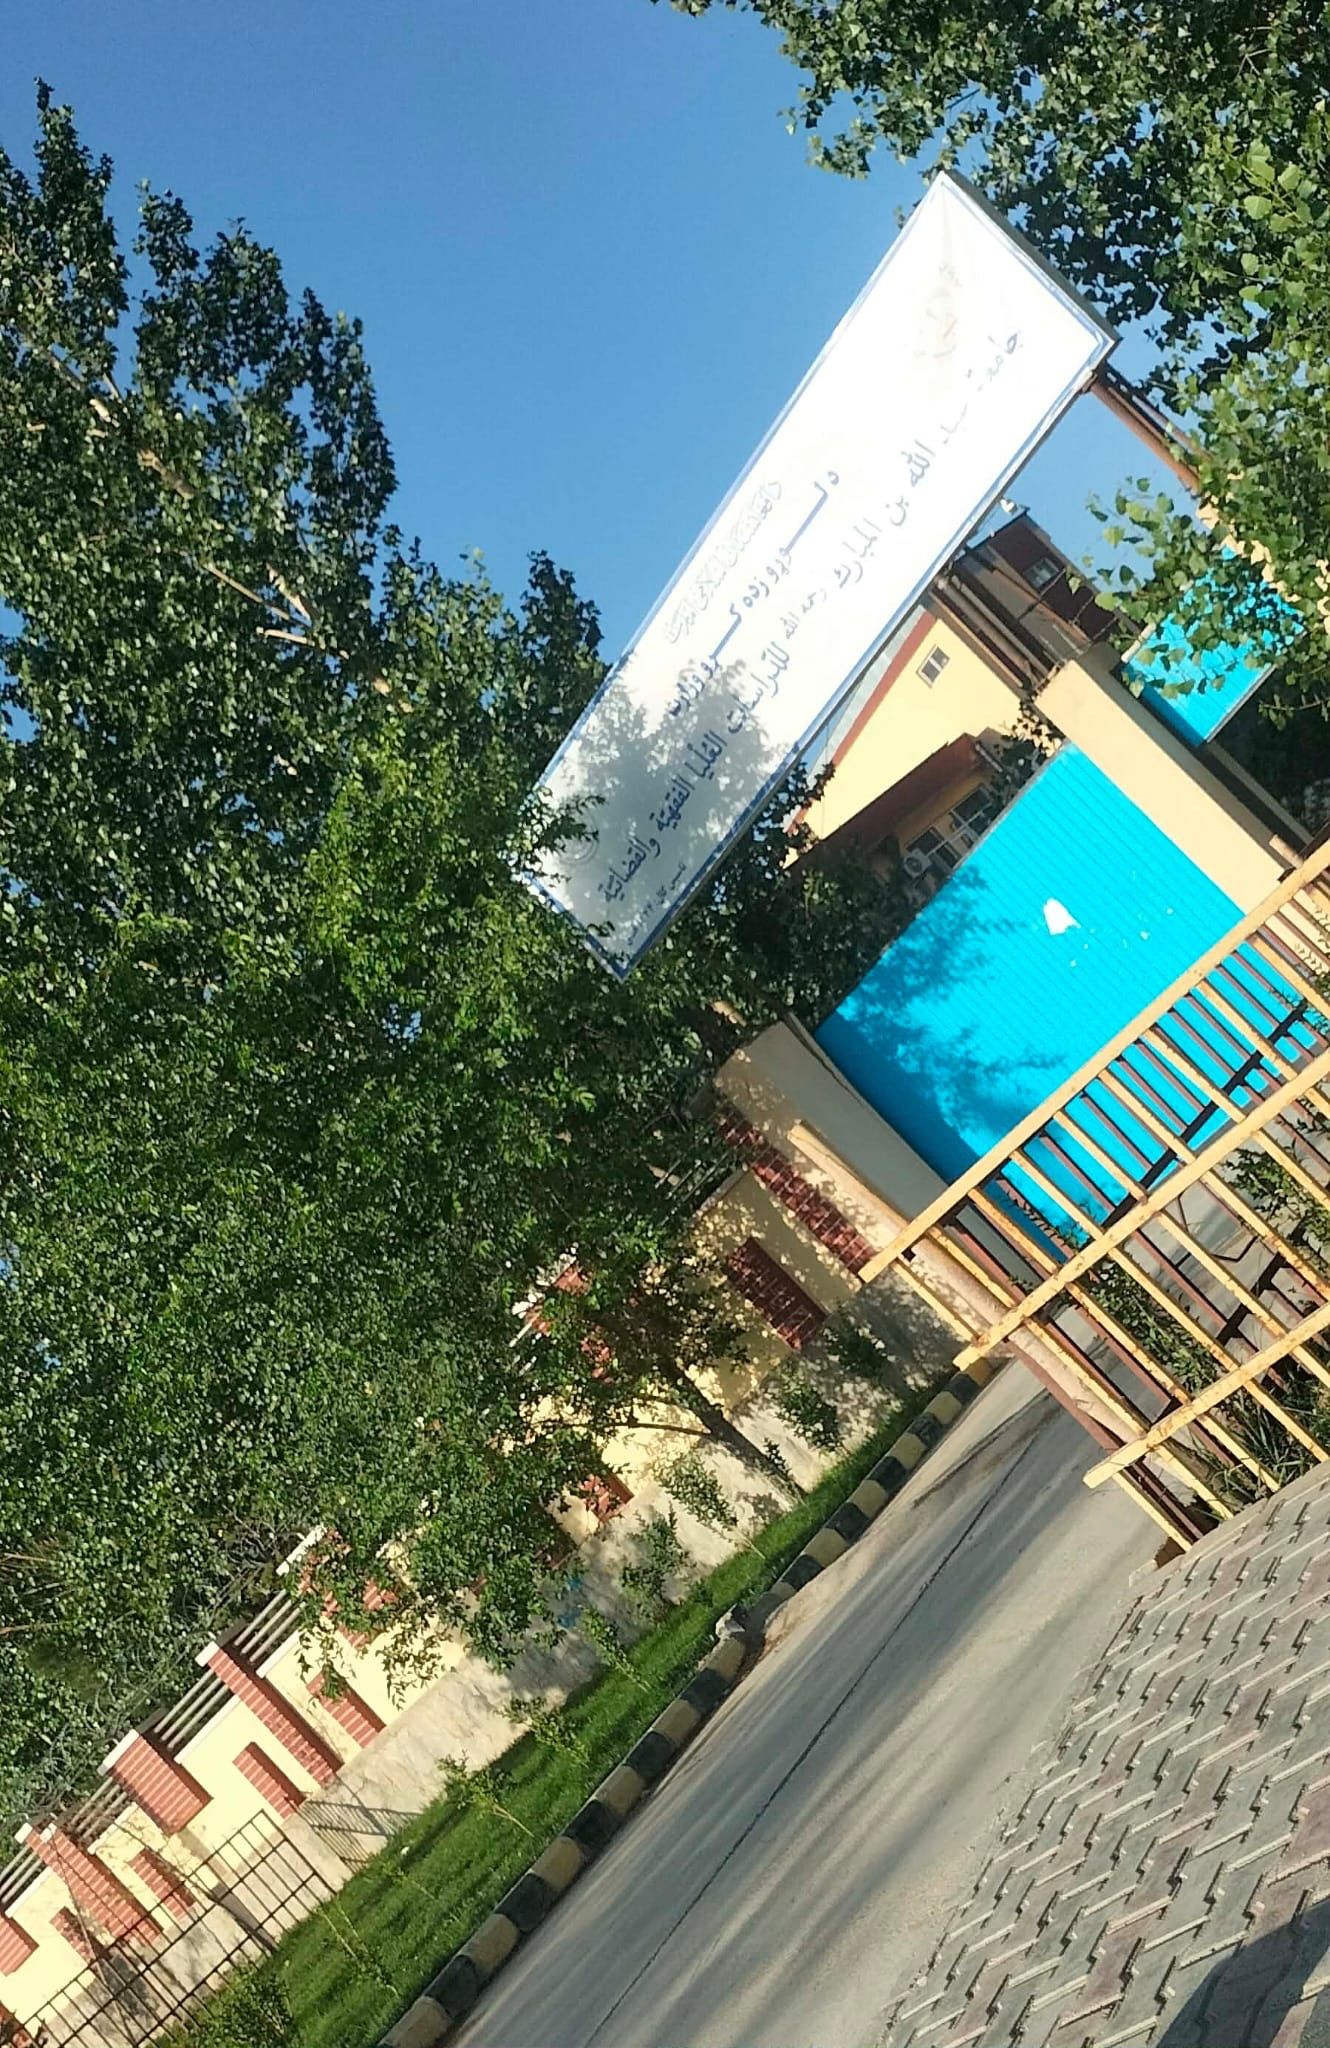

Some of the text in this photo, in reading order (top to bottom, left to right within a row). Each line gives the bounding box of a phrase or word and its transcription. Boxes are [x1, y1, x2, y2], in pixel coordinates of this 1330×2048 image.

[827, 470, 840, 486] د
[900, 438, 936, 487] الله
[885, 495, 910, 526] بن
[742, 575, 770, 608] زده
[666, 673, 706, 717] وزارت
